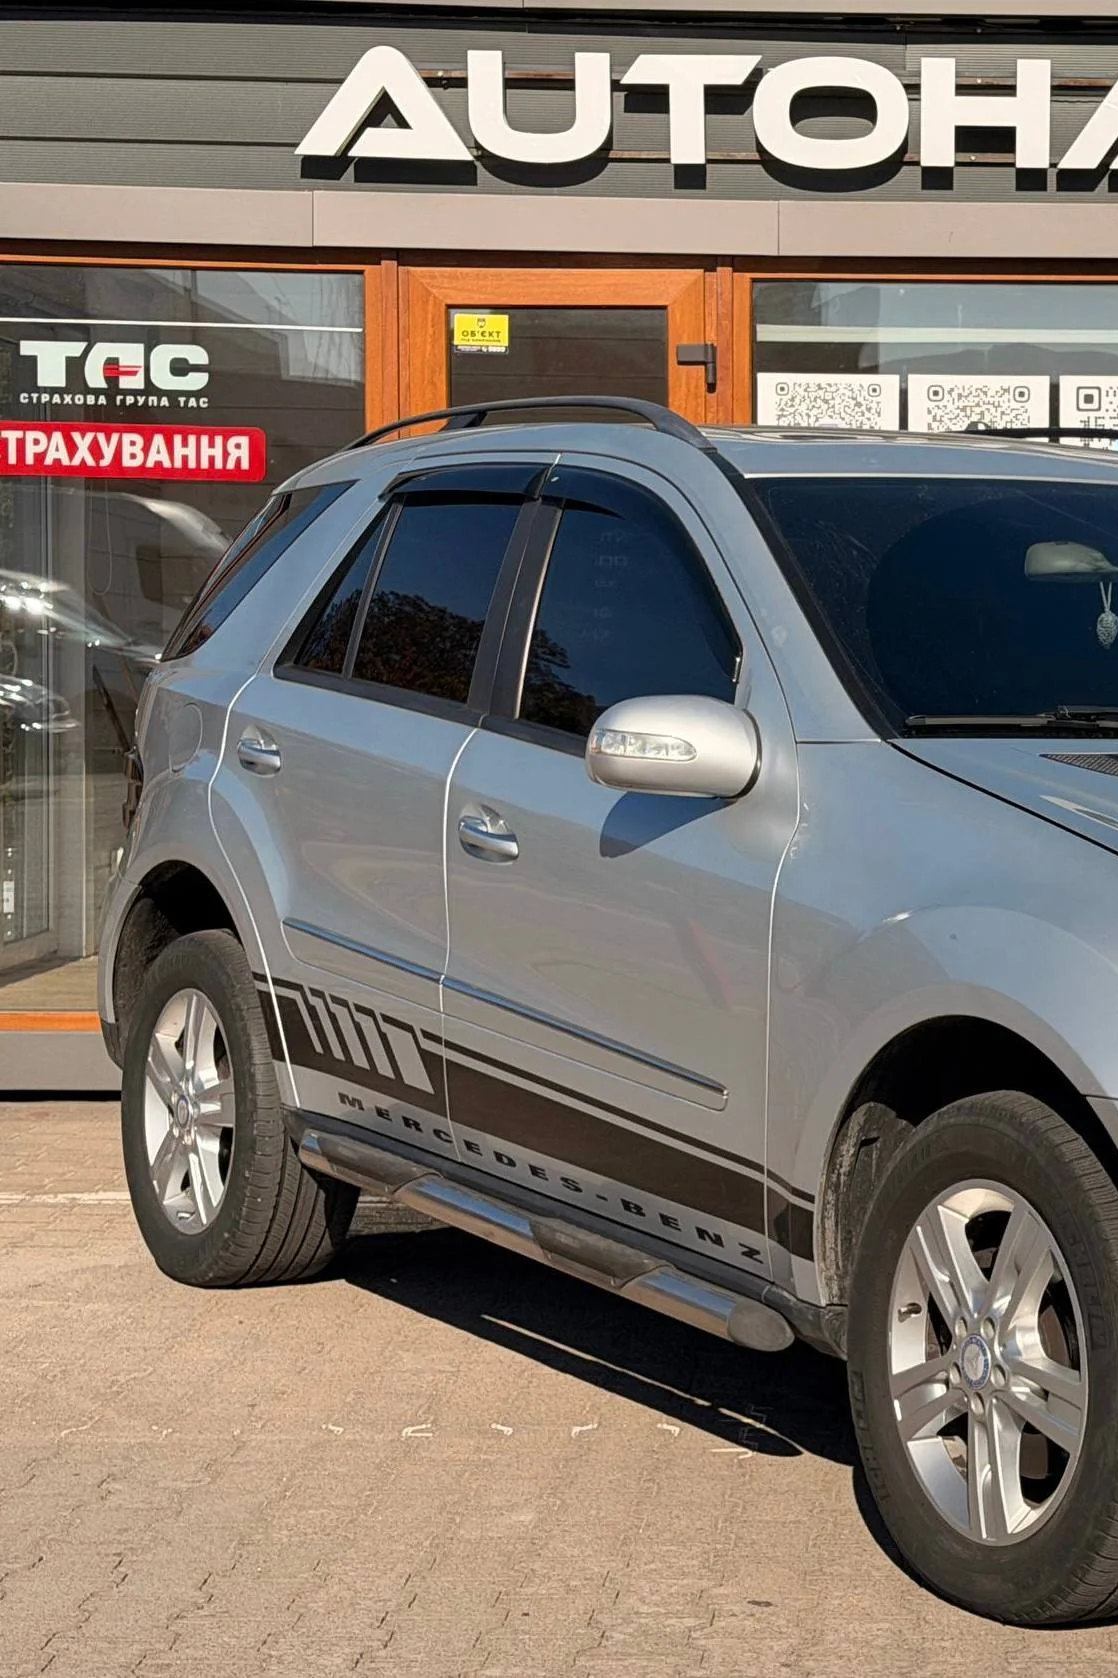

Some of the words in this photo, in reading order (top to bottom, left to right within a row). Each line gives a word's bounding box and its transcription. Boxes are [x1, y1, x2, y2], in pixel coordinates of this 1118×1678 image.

[20, 392, 107, 405] СТРАХОВА
[116, 395, 170, 407] ГРУПА
[178, 396, 209, 408] ТАС
[0, 430, 249, 470] ТРАХУВАННЯ
[338, 1092, 764, 1265] MERCEDES-BENZ
